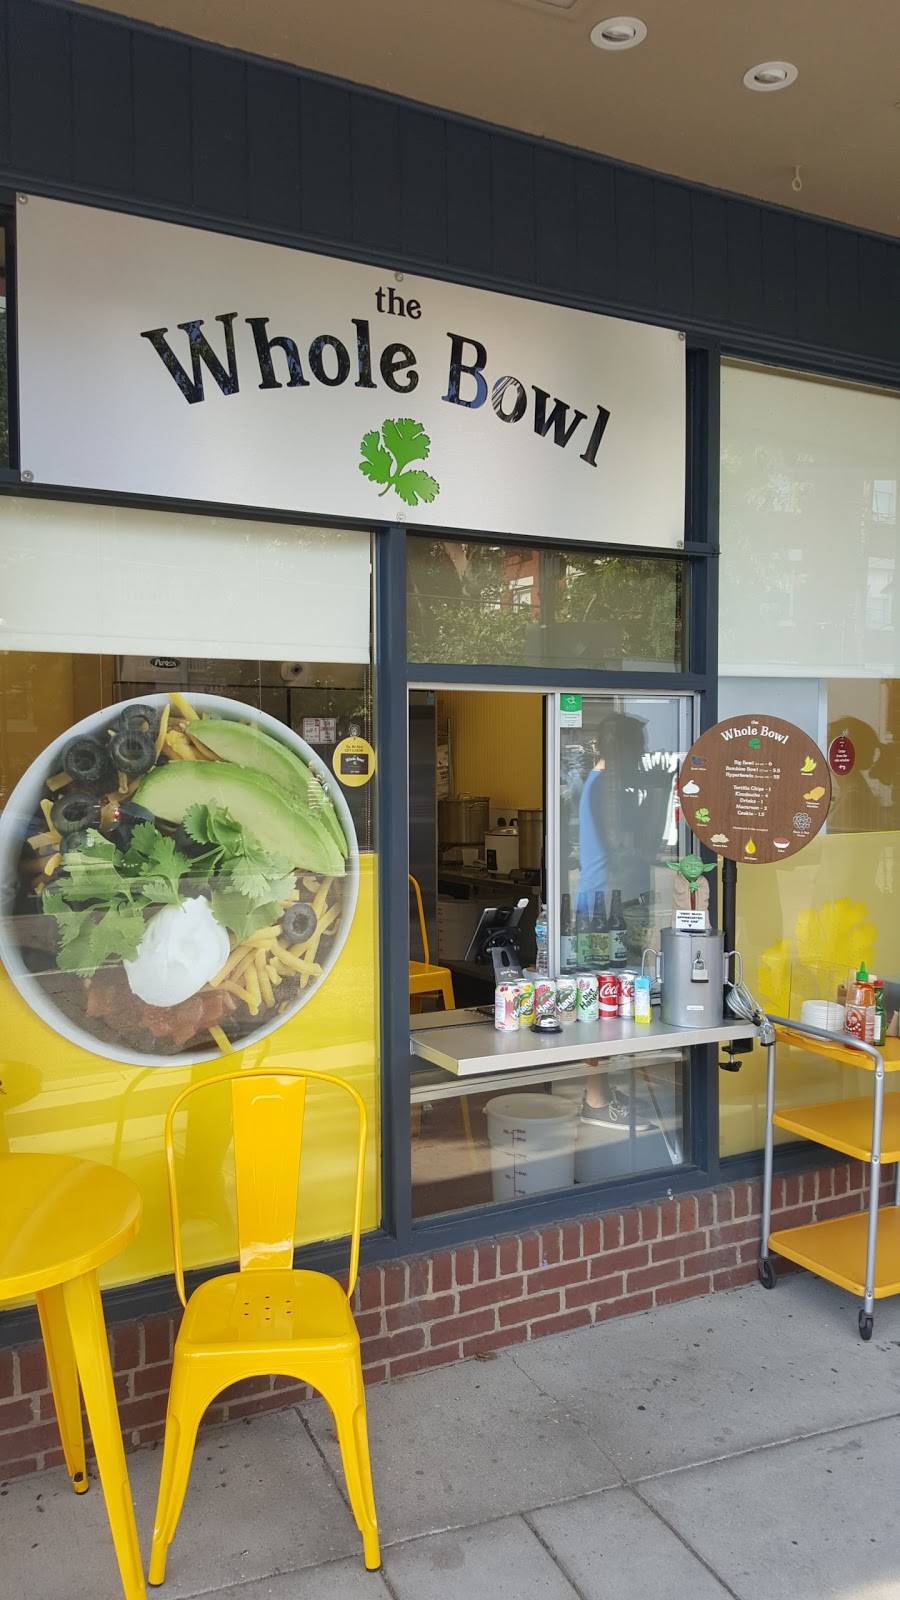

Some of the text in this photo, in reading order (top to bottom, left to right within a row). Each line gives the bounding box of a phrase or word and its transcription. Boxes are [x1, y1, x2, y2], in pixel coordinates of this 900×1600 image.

[374, 285, 422, 319] the
[140, 312, 611, 468] Whole Bowl
[720, 725, 789, 745] Whole Bowl
[583, 987, 595, 1001] Diet
